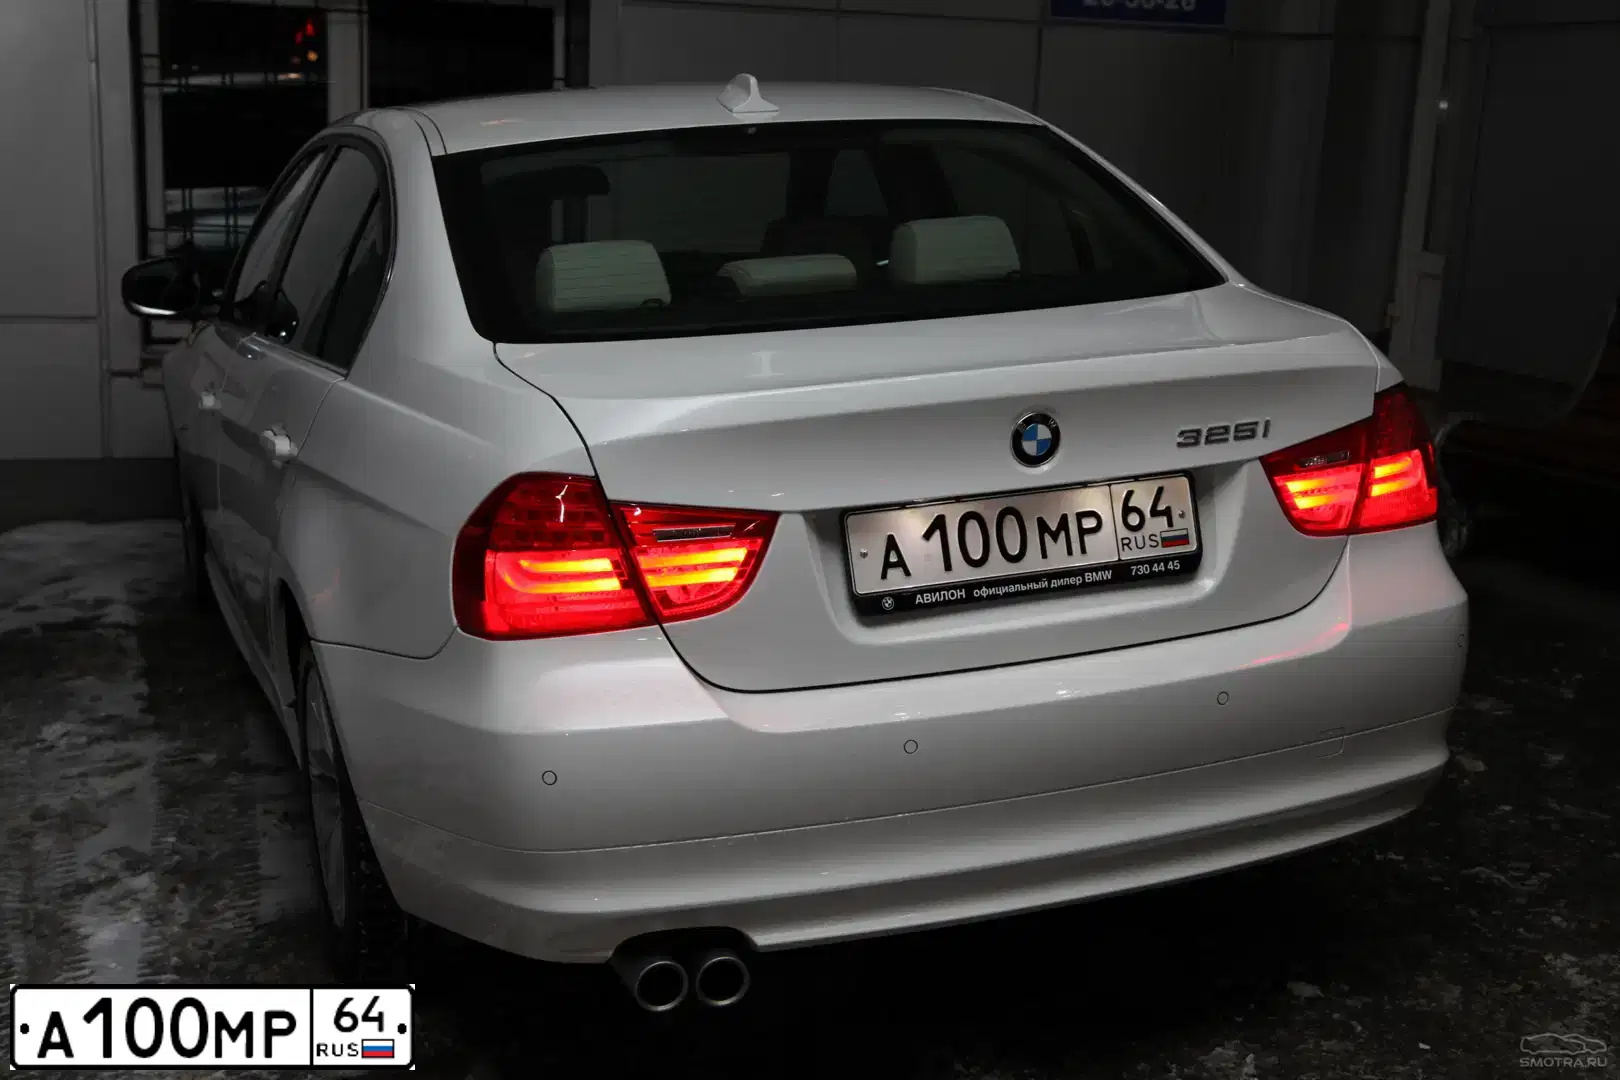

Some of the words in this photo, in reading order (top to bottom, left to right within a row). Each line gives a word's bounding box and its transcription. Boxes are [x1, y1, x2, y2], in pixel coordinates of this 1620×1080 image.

[1120, 486, 1174, 532] 64
[1120, 533, 1161, 552] RUS
[1130, 563, 1150, 577] 730
[1152, 561, 1166, 573] 44
[1167, 559, 1181, 571] 45
[915, 588, 966, 605] АВИЛОН
[973, 578, 1049, 597] официальный
[1050, 574, 1083, 589] дилер
[1084, 569, 1113, 584] BMW
